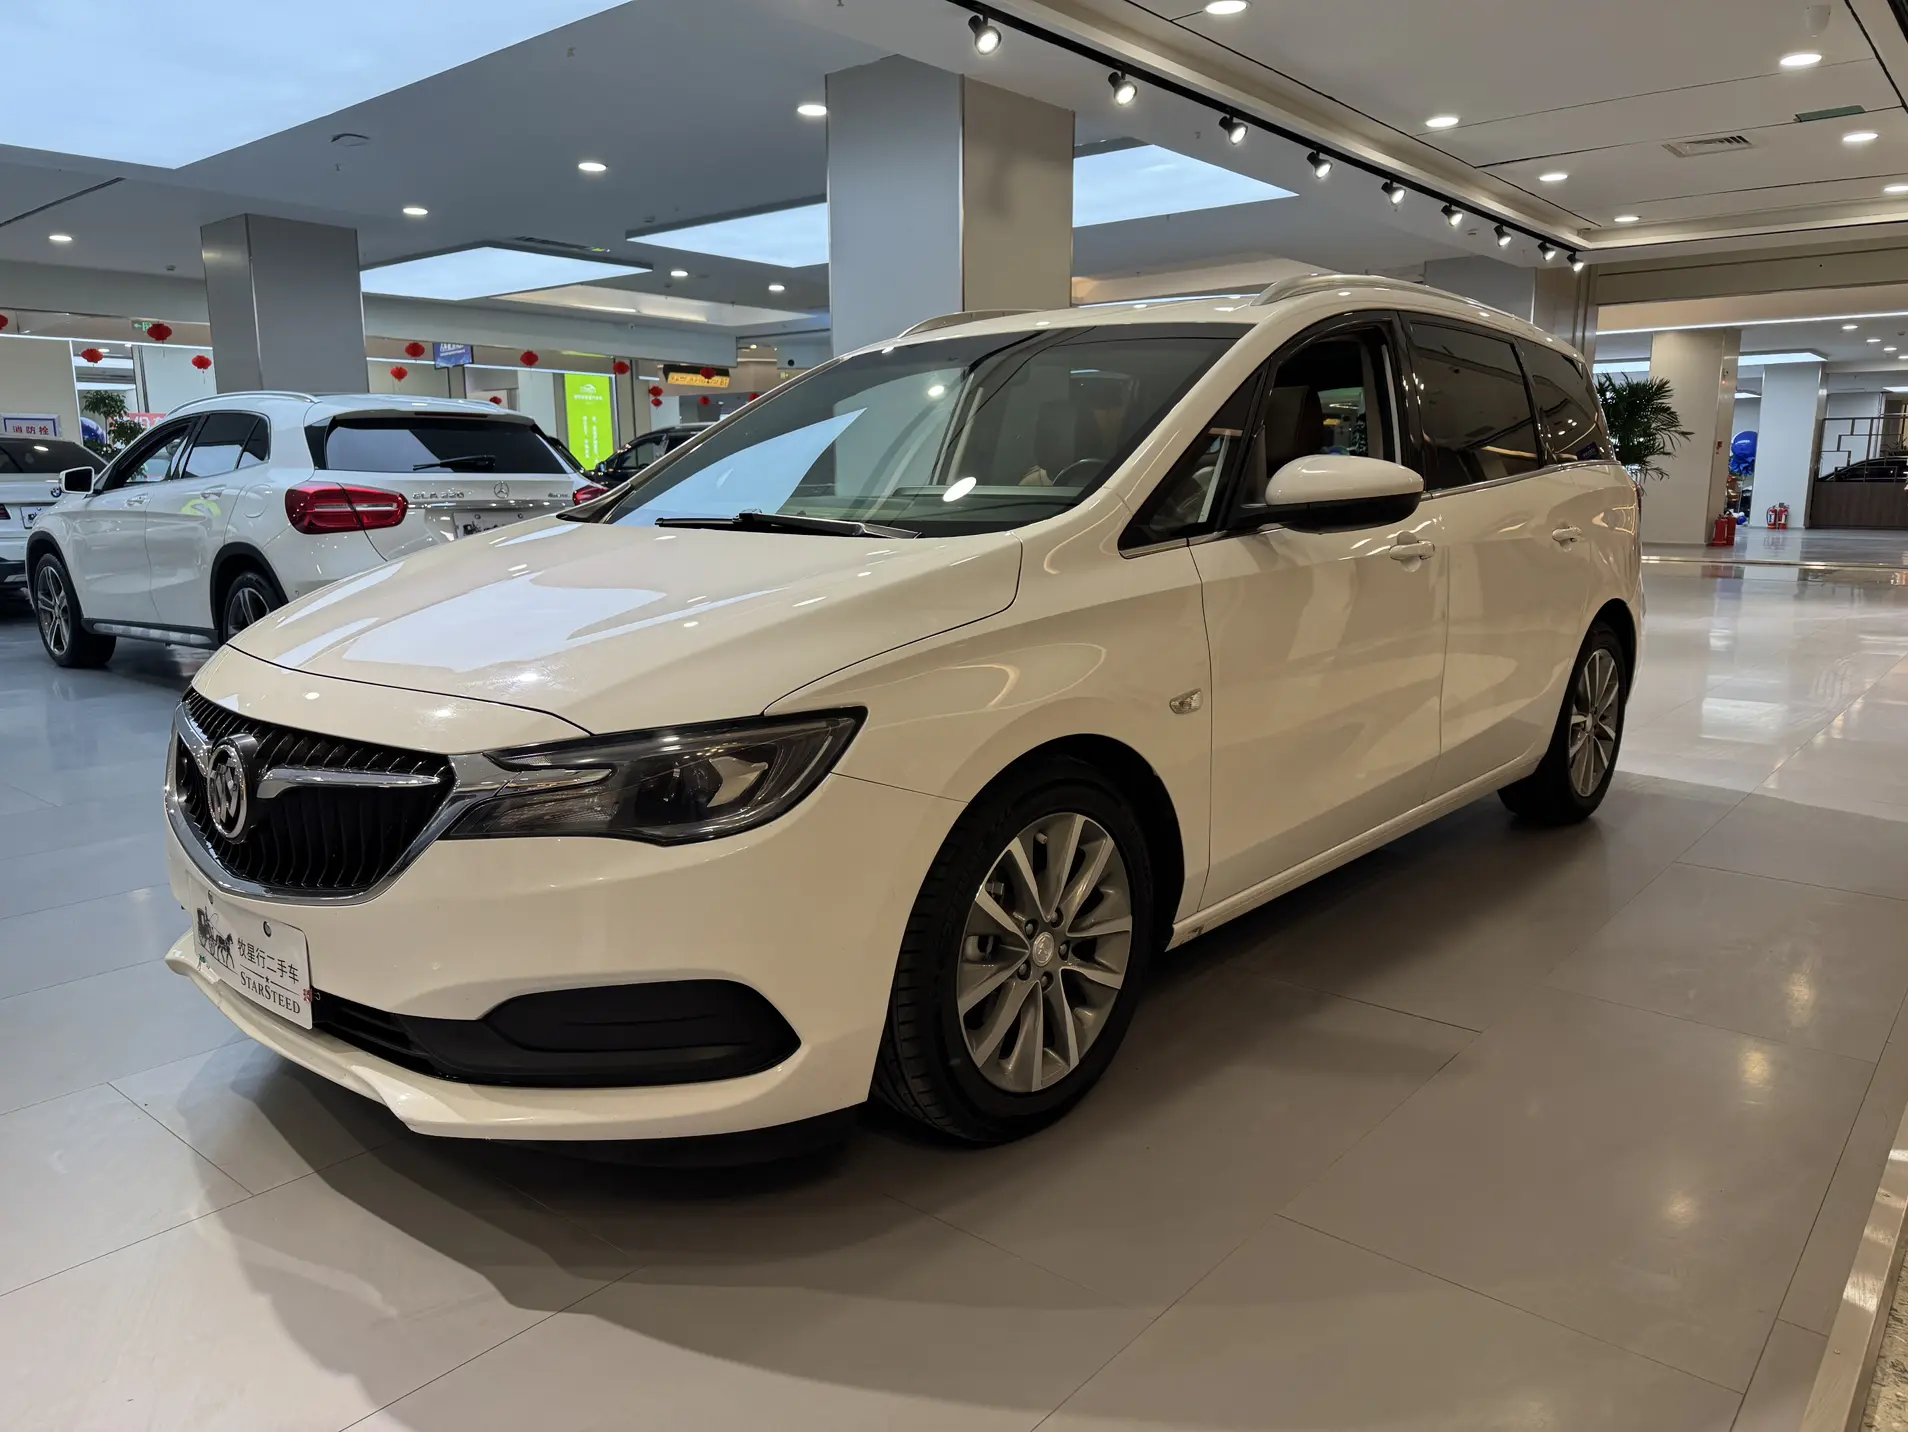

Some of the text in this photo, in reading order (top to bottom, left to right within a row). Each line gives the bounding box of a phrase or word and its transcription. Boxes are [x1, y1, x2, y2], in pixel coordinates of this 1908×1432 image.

[12, 425, 49, 435] 消防栓
[237, 937, 299, 984] 牧星行二手车
